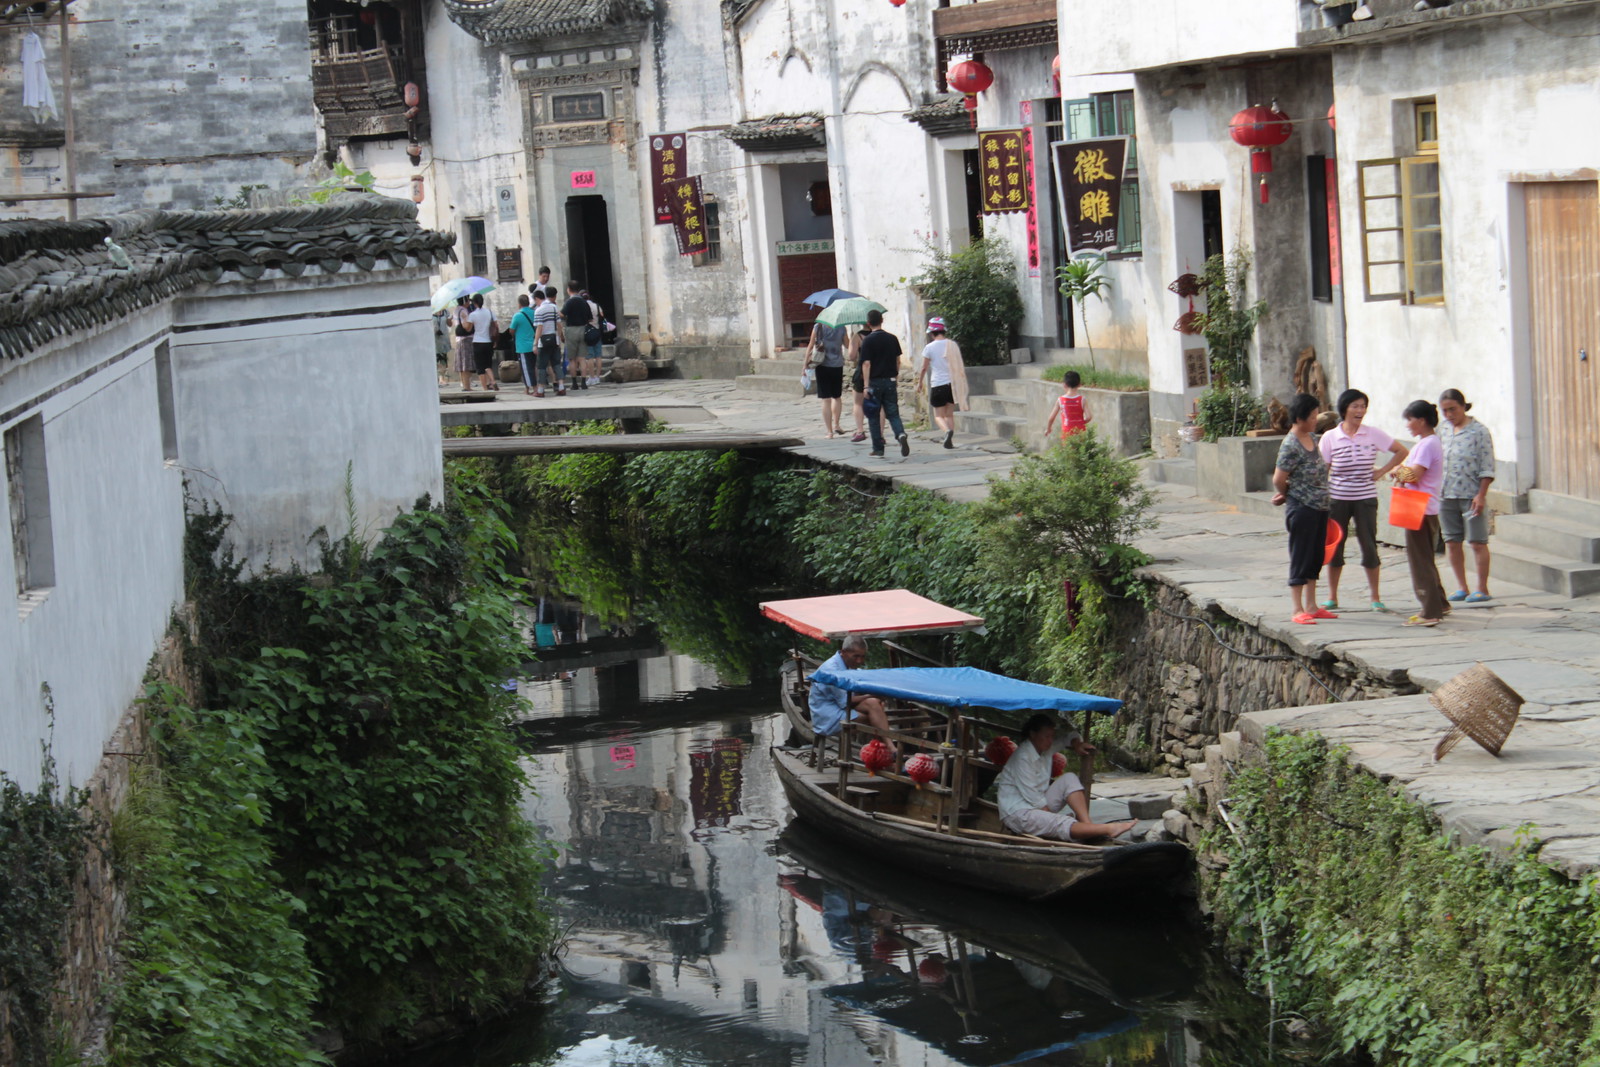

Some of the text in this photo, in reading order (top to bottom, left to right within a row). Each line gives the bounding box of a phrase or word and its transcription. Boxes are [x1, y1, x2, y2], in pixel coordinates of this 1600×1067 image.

[1003, 138, 1022, 204] 杯上留影
[1073, 148, 1116, 225] 徽雕
[1082, 228, 1115, 244] 二分店
